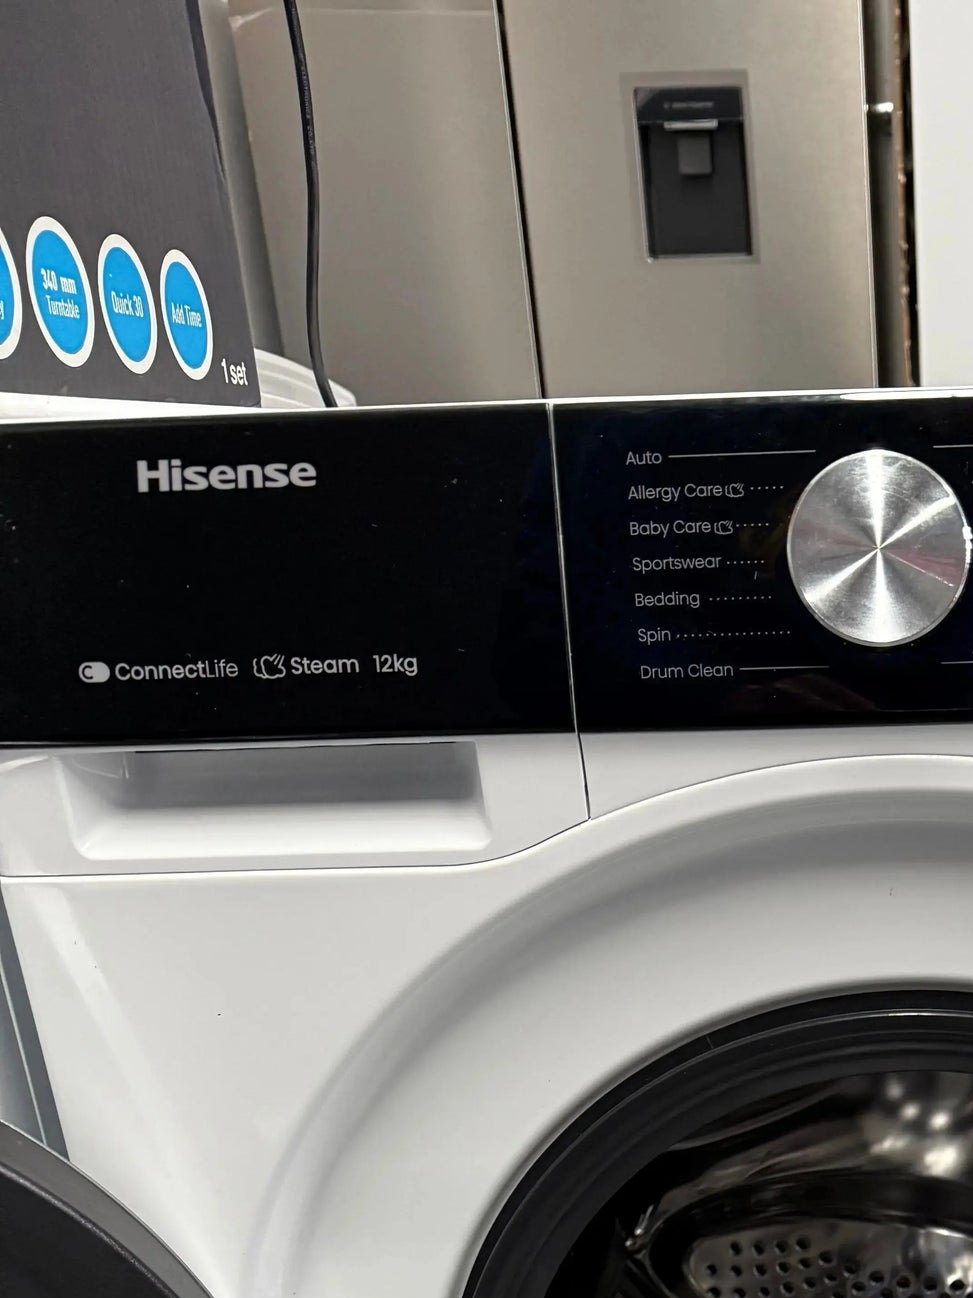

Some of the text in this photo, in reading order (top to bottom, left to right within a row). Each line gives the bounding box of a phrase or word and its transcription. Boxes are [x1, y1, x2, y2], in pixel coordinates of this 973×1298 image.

[40, 268, 77, 295] 340 mm
[45, 295, 81, 319] Turntable
[111, 290, 144, 318] Quick 30
[171, 302, 202, 328] Add Time
[221, 358, 249, 386] 1 set
[625, 451, 663, 466] Auto
[136, 459, 317, 494] Hisense
[627, 484, 723, 502] Allergy Care
[629, 519, 711, 539] Baby Care
[632, 556, 723, 574] Sportswear
[635, 591, 700, 609] Bedding
[637, 627, 672, 645] Spin
[114, 659, 239, 681] ConnectLife
[290, 654, 418, 677] Steam 12kg
[640, 663, 734, 680] Drum Clean
